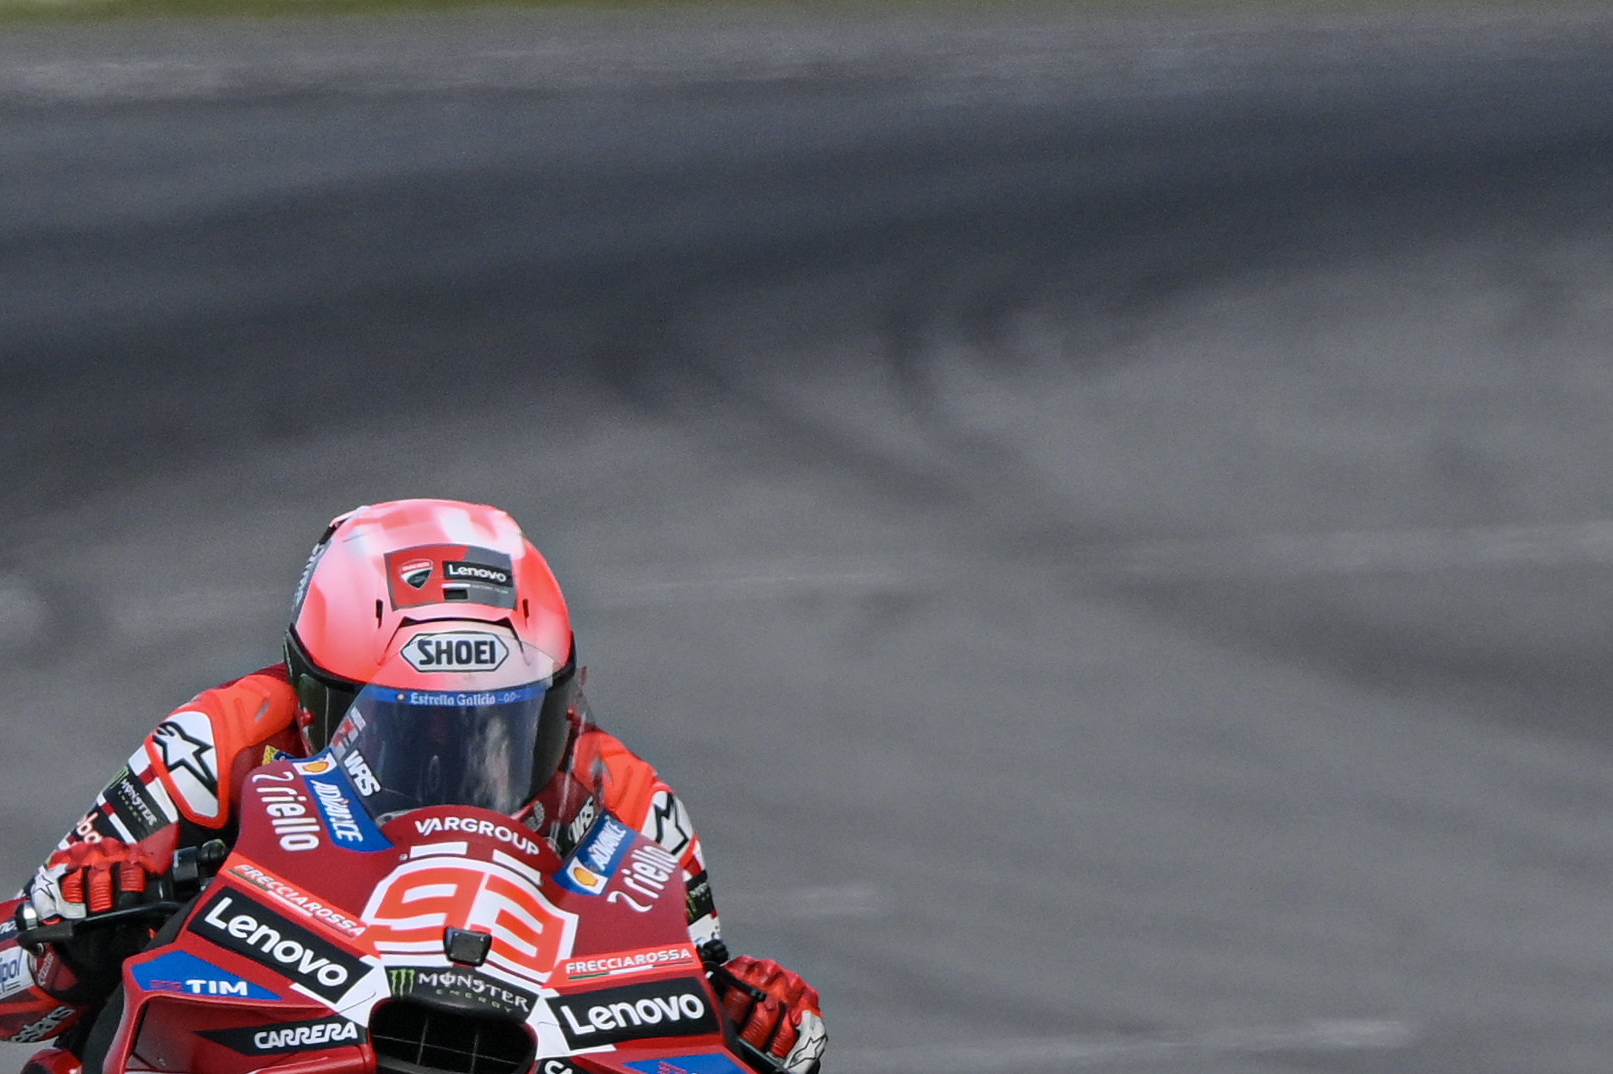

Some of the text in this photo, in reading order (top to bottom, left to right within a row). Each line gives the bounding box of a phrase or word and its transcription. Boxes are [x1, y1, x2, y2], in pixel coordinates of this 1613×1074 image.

[448, 563, 507, 583] Lenovo
[416, 639, 497, 666] SHOEI
[410, 692, 455, 706] Estrella
[456, 693, 496, 706] Galicia
[343, 749, 381, 797] WRS
[309, 779, 364, 843] ADVANCE
[414, 816, 541, 856] VARGROUP
[234, 863, 368, 937] FRECCIAROSSA
[204, 896, 349, 987] Lenovo
[564, 947, 693, 975] FRECCIAROSSA
[185, 979, 249, 996] TIM
[418, 971, 530, 1013] MONSTER
[560, 993, 705, 1036] Lenovo
[254, 1021, 358, 1050] CARRERA
